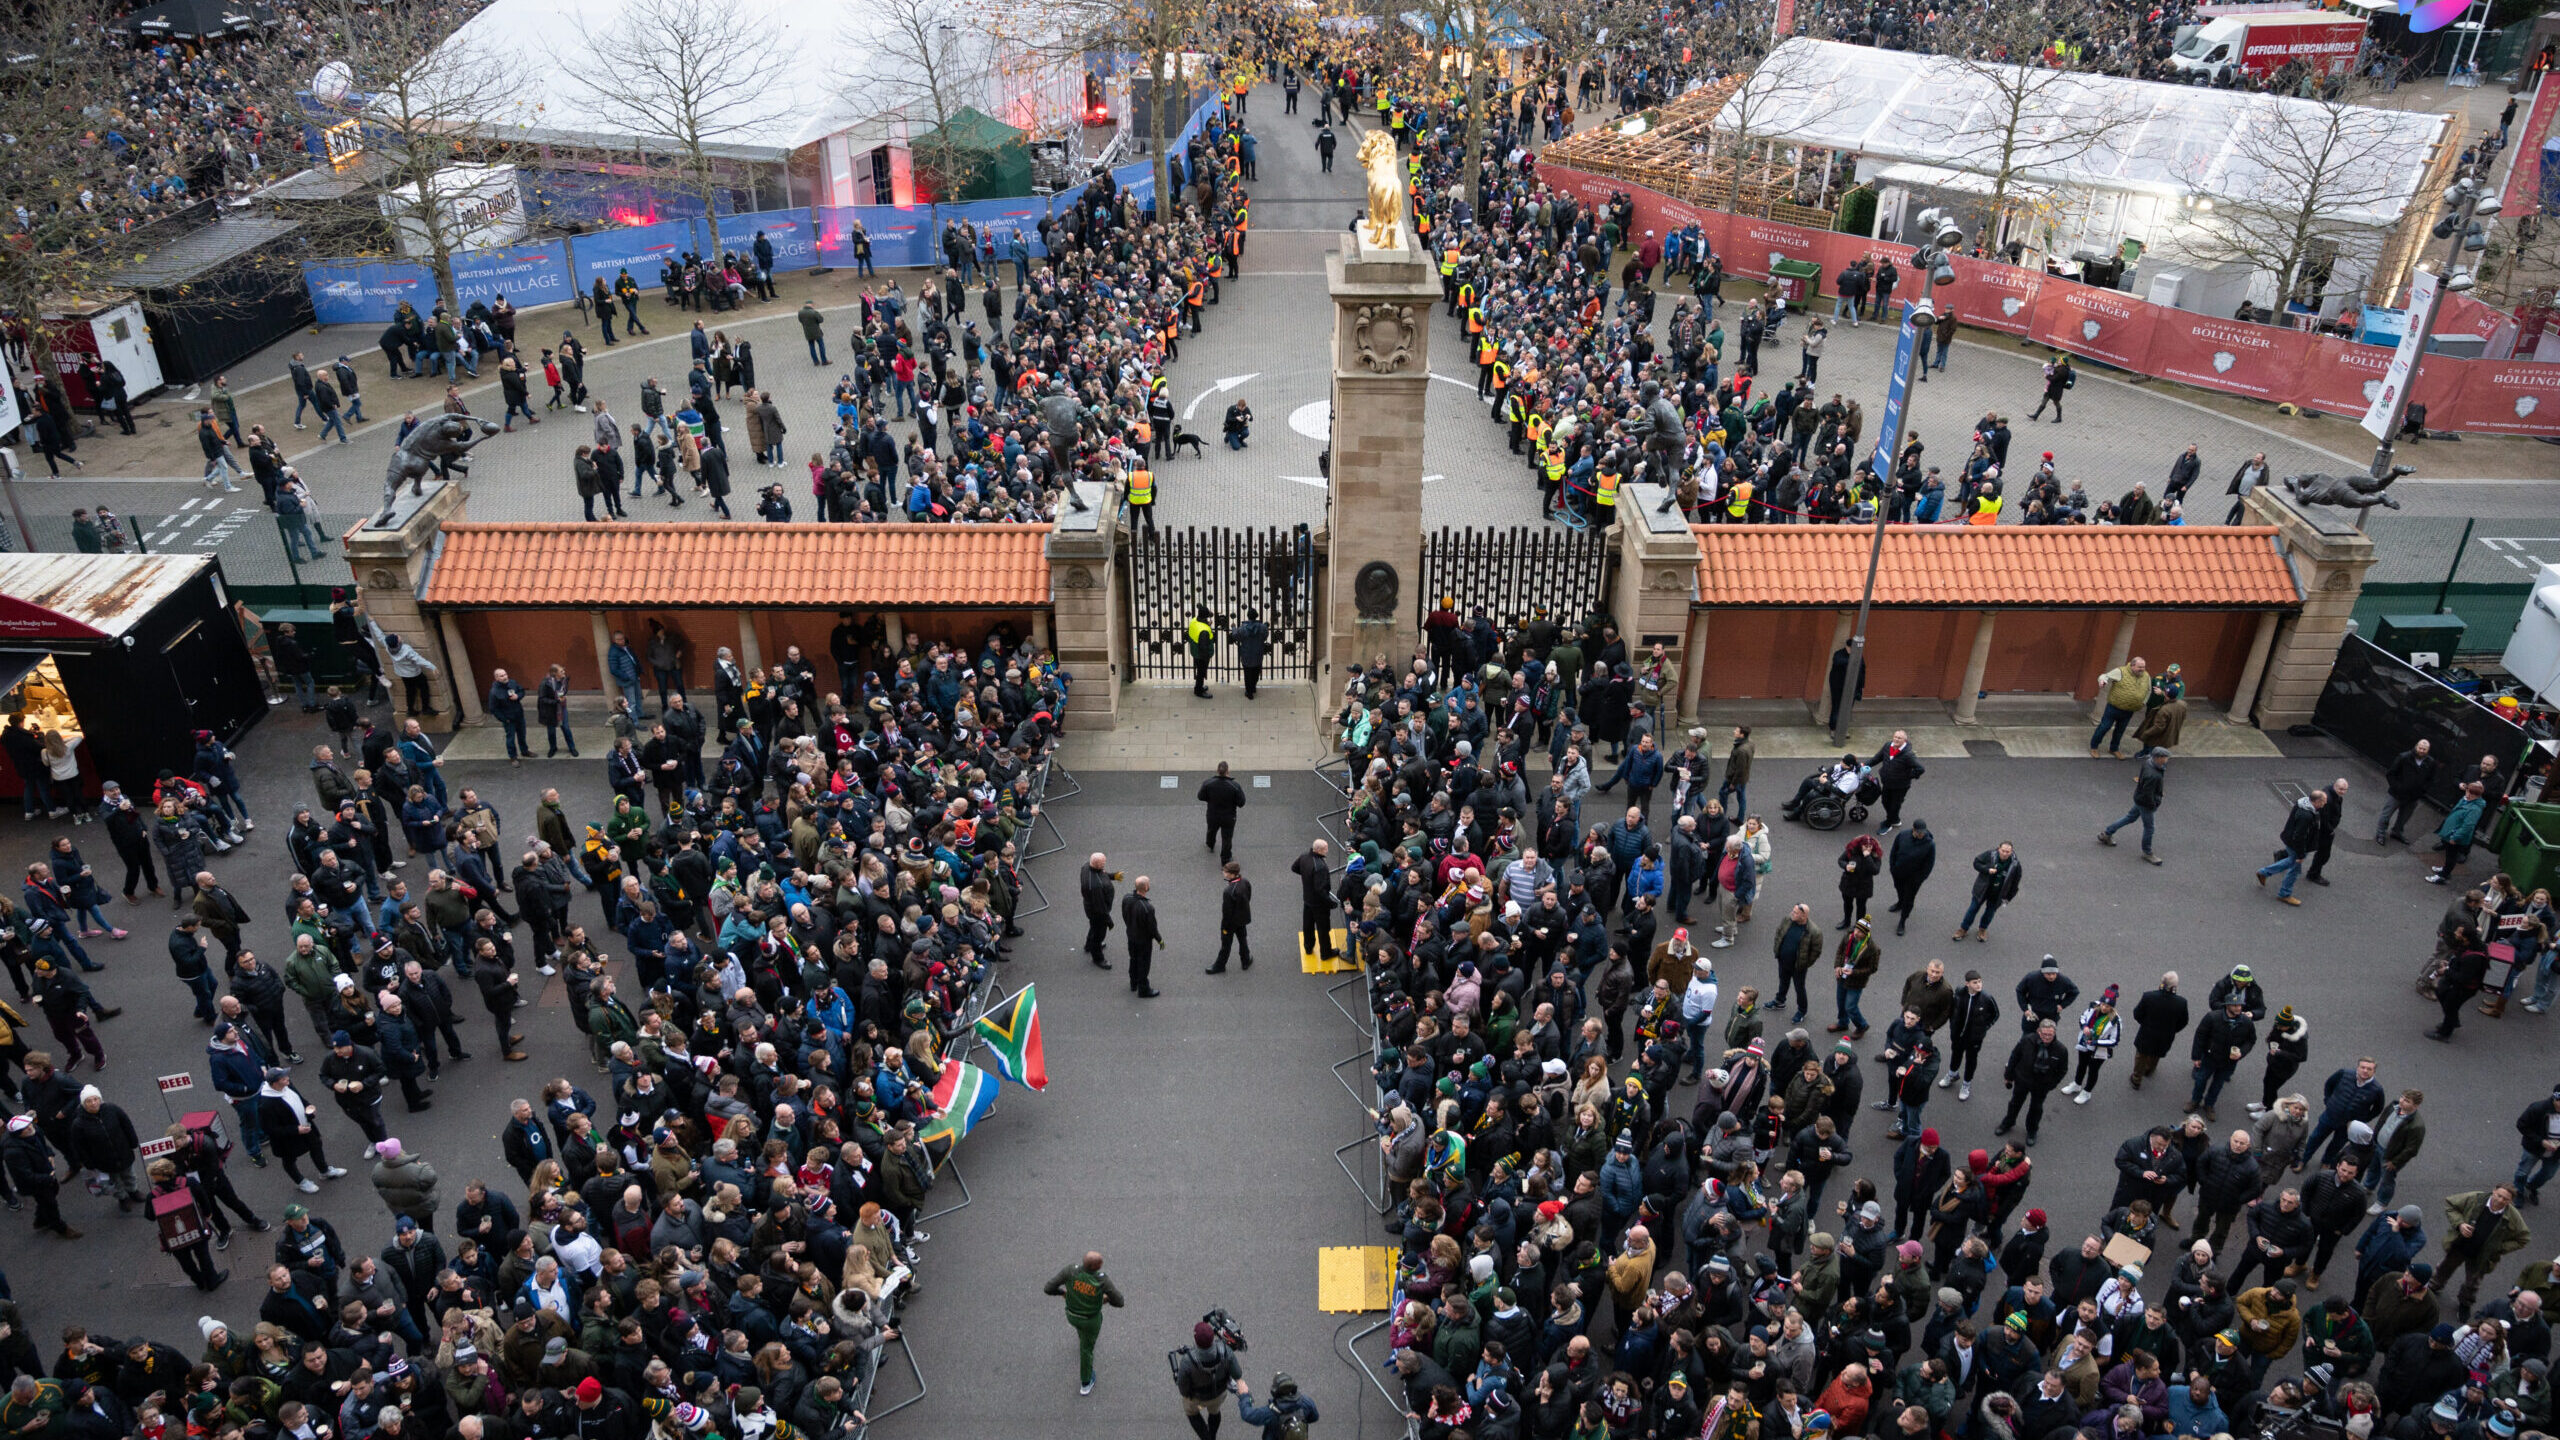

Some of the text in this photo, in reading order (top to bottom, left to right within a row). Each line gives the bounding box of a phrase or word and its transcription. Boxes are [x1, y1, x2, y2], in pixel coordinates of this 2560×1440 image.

[2247, 42, 2357, 56] OFFICIAL MERCHANDISE
[985, 217, 1018, 227] AIRWAYS
[719, 234, 748, 245] RITISH
[869, 232, 903, 241] AIRWAYS
[1750, 230, 1809, 248] BOLLINGER
[591, 252, 662, 269] BRITISH AIRWAYS
[458, 263, 533, 280] BRITISH AIRWAYS
[456, 274, 561, 299] FAN VILLAGE
[1982, 274, 2041, 291] BOLLINGE
[2066, 294, 2130, 319] BOLLINGER
[2191, 326, 2271, 348] BOLLINGER
[2204, 321, 2262, 337] CHAMPAGNE
[2354, 349, 2394, 360] CHAMPA
[2493, 374, 2560, 386] BOLLING
[2507, 368, 2560, 376] CHAMPAGN
[2336, 402, 2369, 412] CHAMPAGN
[192, 508, 260, 546] ENTRY
[2499, 916, 2523, 926] BEER
[160, 1076, 191, 1090] BEER
[141, 1140, 175, 1157] BEER
[168, 1229, 200, 1248] BEER
